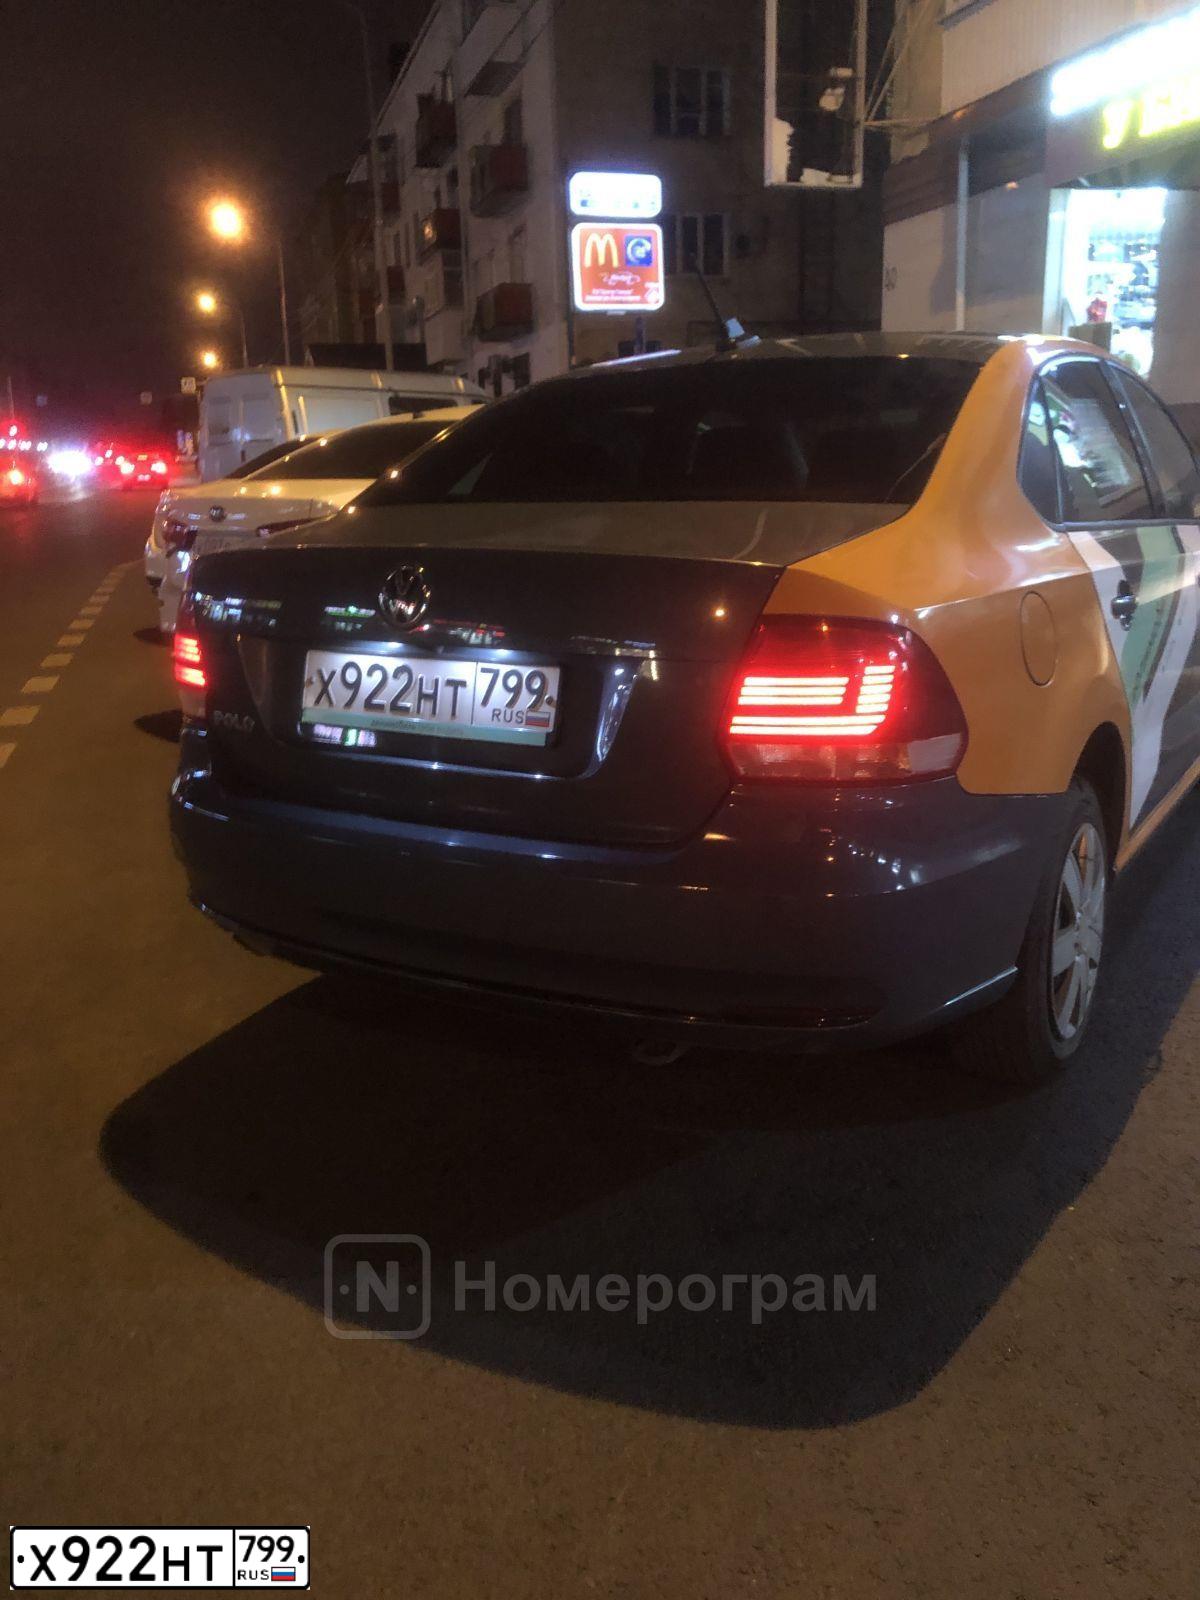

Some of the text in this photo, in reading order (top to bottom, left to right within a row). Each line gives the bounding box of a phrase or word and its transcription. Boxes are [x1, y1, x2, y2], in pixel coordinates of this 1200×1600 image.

[480, 667, 546, 711] 799
[213, 710, 256, 733] POLO
[491, 708, 524, 725] RUS
